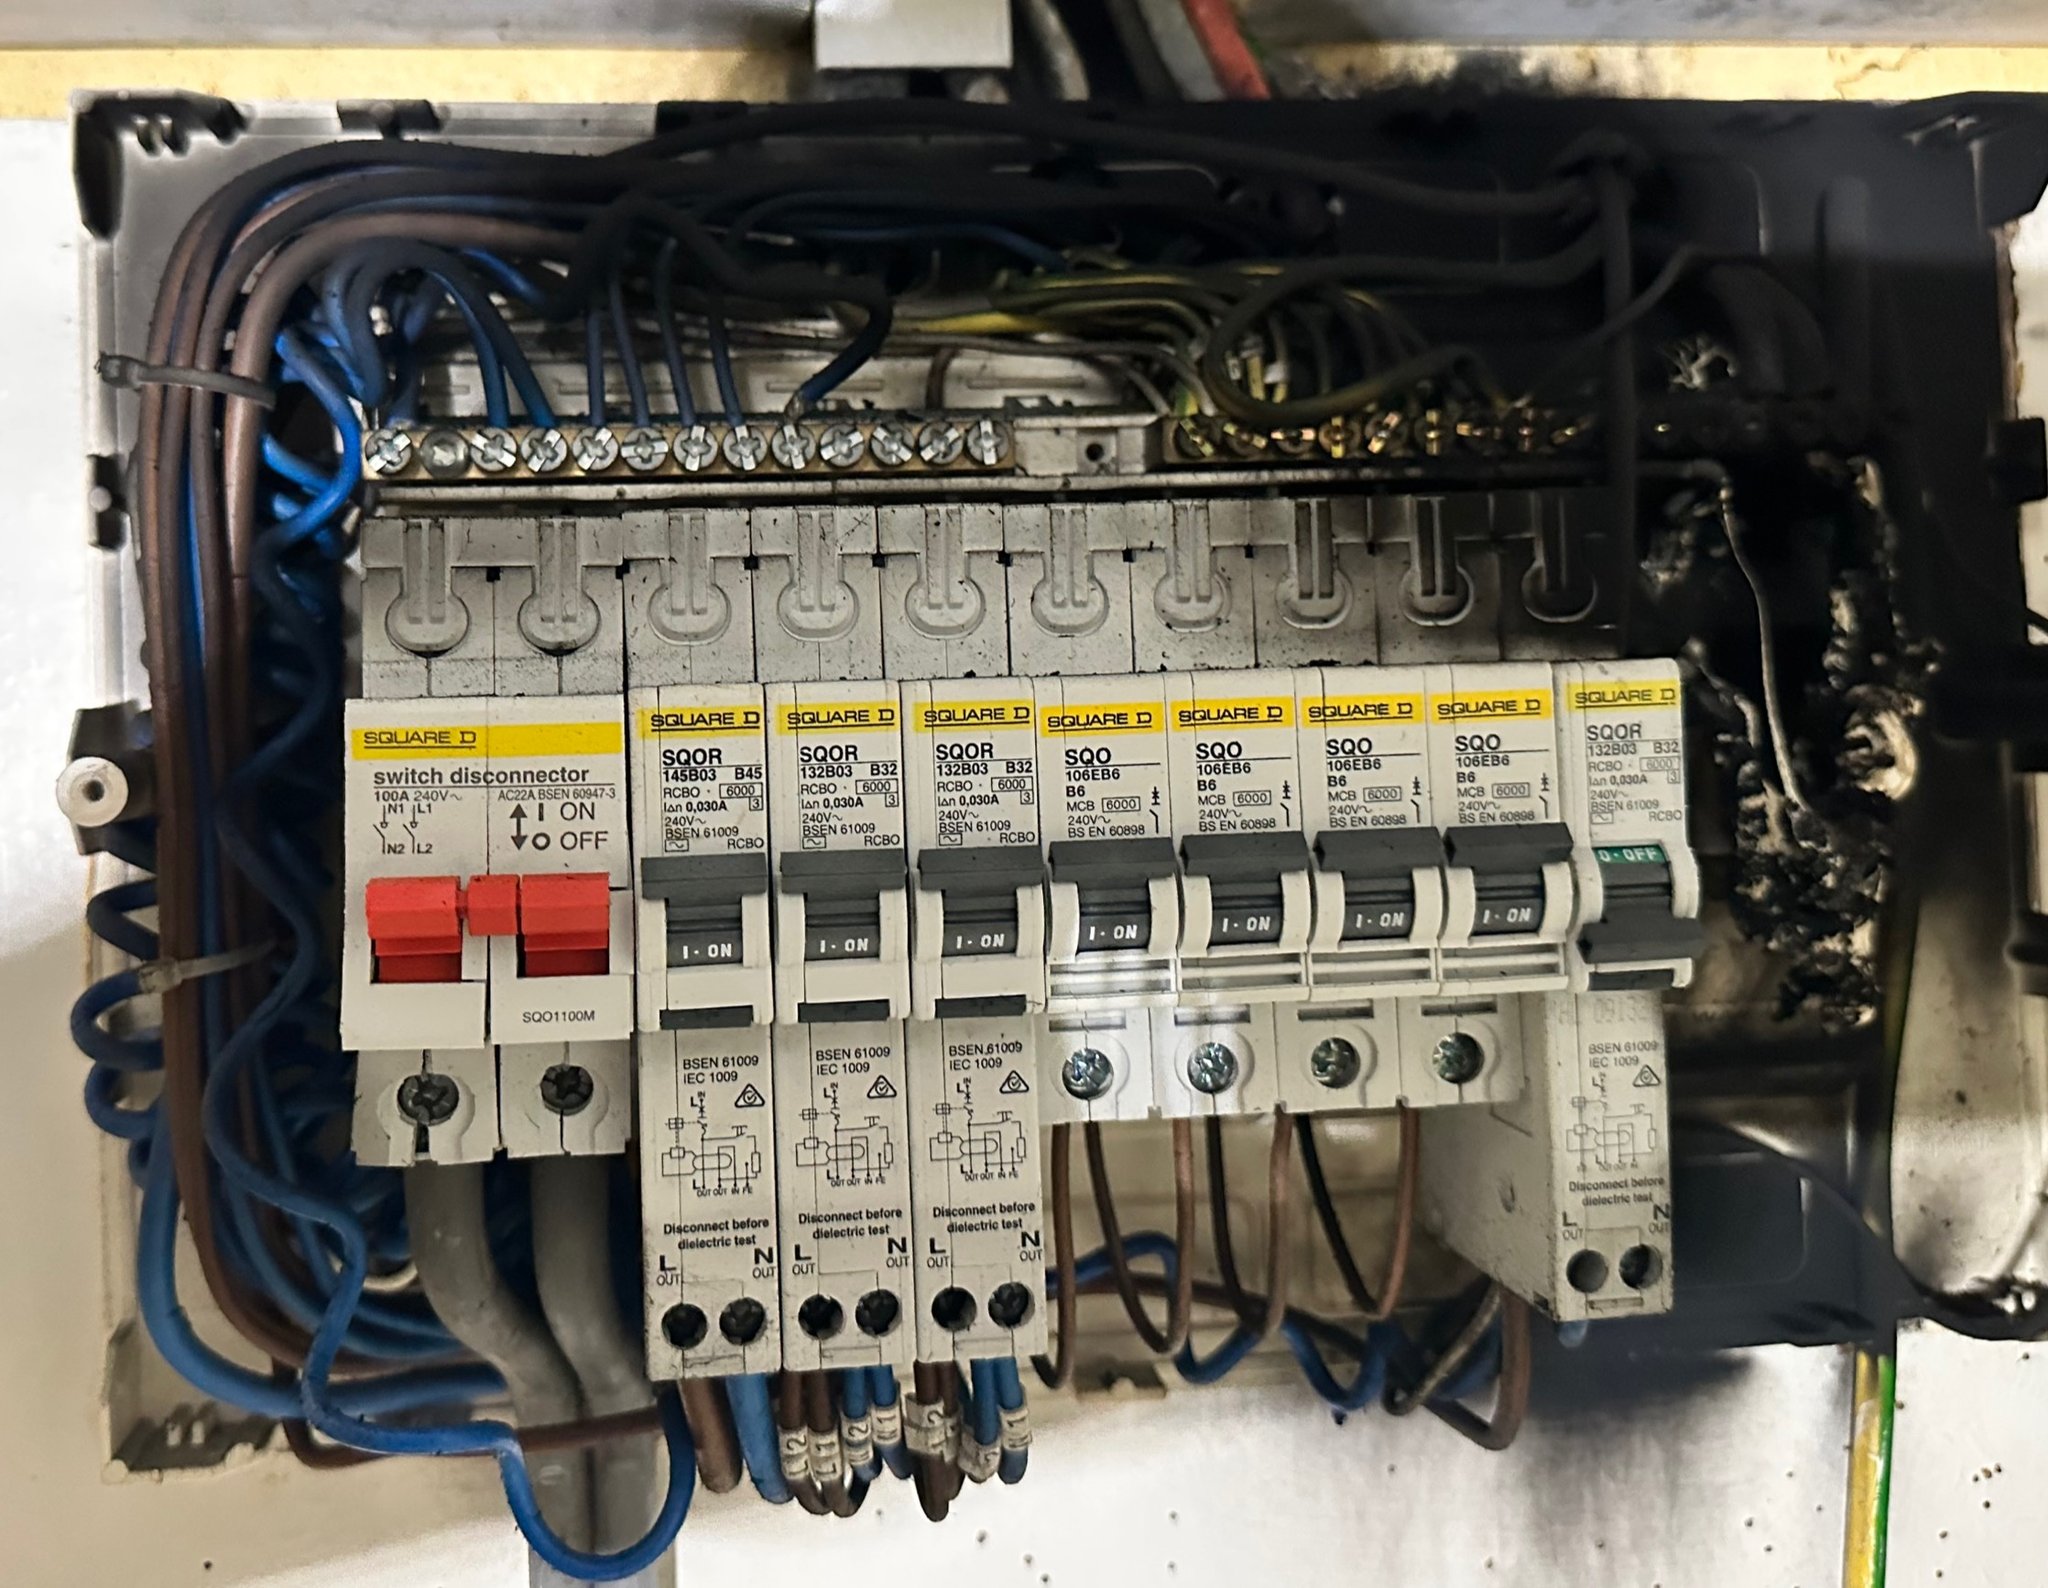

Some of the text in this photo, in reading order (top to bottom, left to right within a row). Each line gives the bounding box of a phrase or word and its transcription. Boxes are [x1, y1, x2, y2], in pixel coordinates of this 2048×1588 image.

[1575, 688, 1676, 704] SQUARE D
[1178, 706, 1283, 722] SQUARE D
[1308, 702, 1413, 718] SQUARE D
[1437, 699, 1541, 715] SQUARE D
[650, 711, 760, 727] SQUARE D
[787, 708, 895, 724] SQUARE D
[924, 707, 1030, 723] SQUARE D
[1048, 712, 1152, 727] SQUARE D
[363, 731, 477, 745] SQUARE D
[1587, 723, 1642, 741] SQOR
[1326, 737, 1373, 756] SQO
[1455, 733, 1501, 752] SQO
[1588, 741, 1679, 756] 132B03 B32
[662, 748, 722, 766] SQOR
[799, 745, 858, 762] SQOR
[935, 742, 994, 761] SQOR
[1064, 747, 1112, 766] SQO
[1196, 741, 1243, 760] SQO
[936, 761, 1033, 776] 132B03 B32
[1197, 762, 1251, 775] 106EB6
[1327, 758, 1382, 772] 106EB6
[1456, 755, 1510, 768] 106EB6
[1588, 759, 1673, 772] RCBO 6000
[373, 766, 589, 786] switch disconnector
[663, 767, 763, 783] 145B03 B45
[800, 763, 898, 779] 132B03 B32
[1065, 768, 1120, 782] 106EB6
[1456, 772, 1476, 784] B6
[800, 781, 891, 795] RCBO 6000
[937, 779, 1026, 792] RCBO 6000
[1197, 779, 1217, 791] B6
[1328, 775, 1347, 787] B6
[374, 790, 410, 802] 100A
[498, 787, 616, 801] AC22A BSEN 60947-3
[663, 785, 755, 799] RCBO 6000
[1066, 785, 1086, 797] B6
[1328, 788, 1398, 802] MCB 6000
[1457, 785, 1526, 798] MCB 6000
[822, 797, 864, 809] 0,030A
[959, 794, 999, 806] 0,030A
[1066, 799, 1137, 812] MCB 6000
[1198, 792, 1267, 805] MCB 6000
[1591, 799, 1659, 812] BSEN 61009
[388, 803, 404, 814] N1
[417, 803, 432, 814] L1
[559, 802, 595, 821] ON
[685, 801, 728, 812] 0,030A
[1329, 814, 1407, 828] BS EN 60898
[1458, 810, 1535, 824] BS EN 60898
[1648, 809, 1682, 821] RCBO
[802, 823, 875, 836] BSEN 61009
[939, 820, 1011, 833] BSEN 61009
[1068, 825, 1145, 838] BS EN 60898
[1199, 818, 1276, 832] BS EN 60898
[665, 826, 739, 839] BSEN 61009
[999, 832, 1035, 844] RCBO
[560, 831, 609, 850] OFF
[727, 838, 764, 849] RCBO
[864, 835, 900, 847] RCBO
[387, 843, 405, 854] N2
[417, 842, 433, 854] L2
[1625, 848, 1658, 861] OFF
[1376, 911, 1404, 928] ON
[1504, 907, 1531, 923] ON
[1112, 922, 1139, 940] ON
[1243, 915, 1271, 933] ON
[844, 938, 869, 953] ON
[980, 933, 1005, 948] ON
[707, 943, 732, 958] ON
[522, 1010, 595, 1023] SQO1100M
[816, 1047, 891, 1061] BSEN 61009
[949, 1041, 1023, 1057] BSEN 61009
[683, 1055, 759, 1070] BSEN 61009
[816, 1062, 871, 1075] IEC 1009
[950, 1057, 1002, 1071] IEC 1009
[683, 1071, 738, 1084] IEC 1009
[798, 1208, 903, 1225] Disconnect before
[933, 1201, 1036, 1218] Disconnect before
[663, 1217, 769, 1235] Disconnect before
[813, 1224, 890, 1240] dielectric test
[947, 1217, 1023, 1234] dielectric test
[677, 1234, 757, 1250] dielectric test
[887, 1236, 907, 1255] N
[929, 1237, 946, 1255] L
[1020, 1230, 1041, 1248] N
[754, 1247, 774, 1264] N
[794, 1244, 812, 1261] L
[659, 1255, 676, 1271] L
